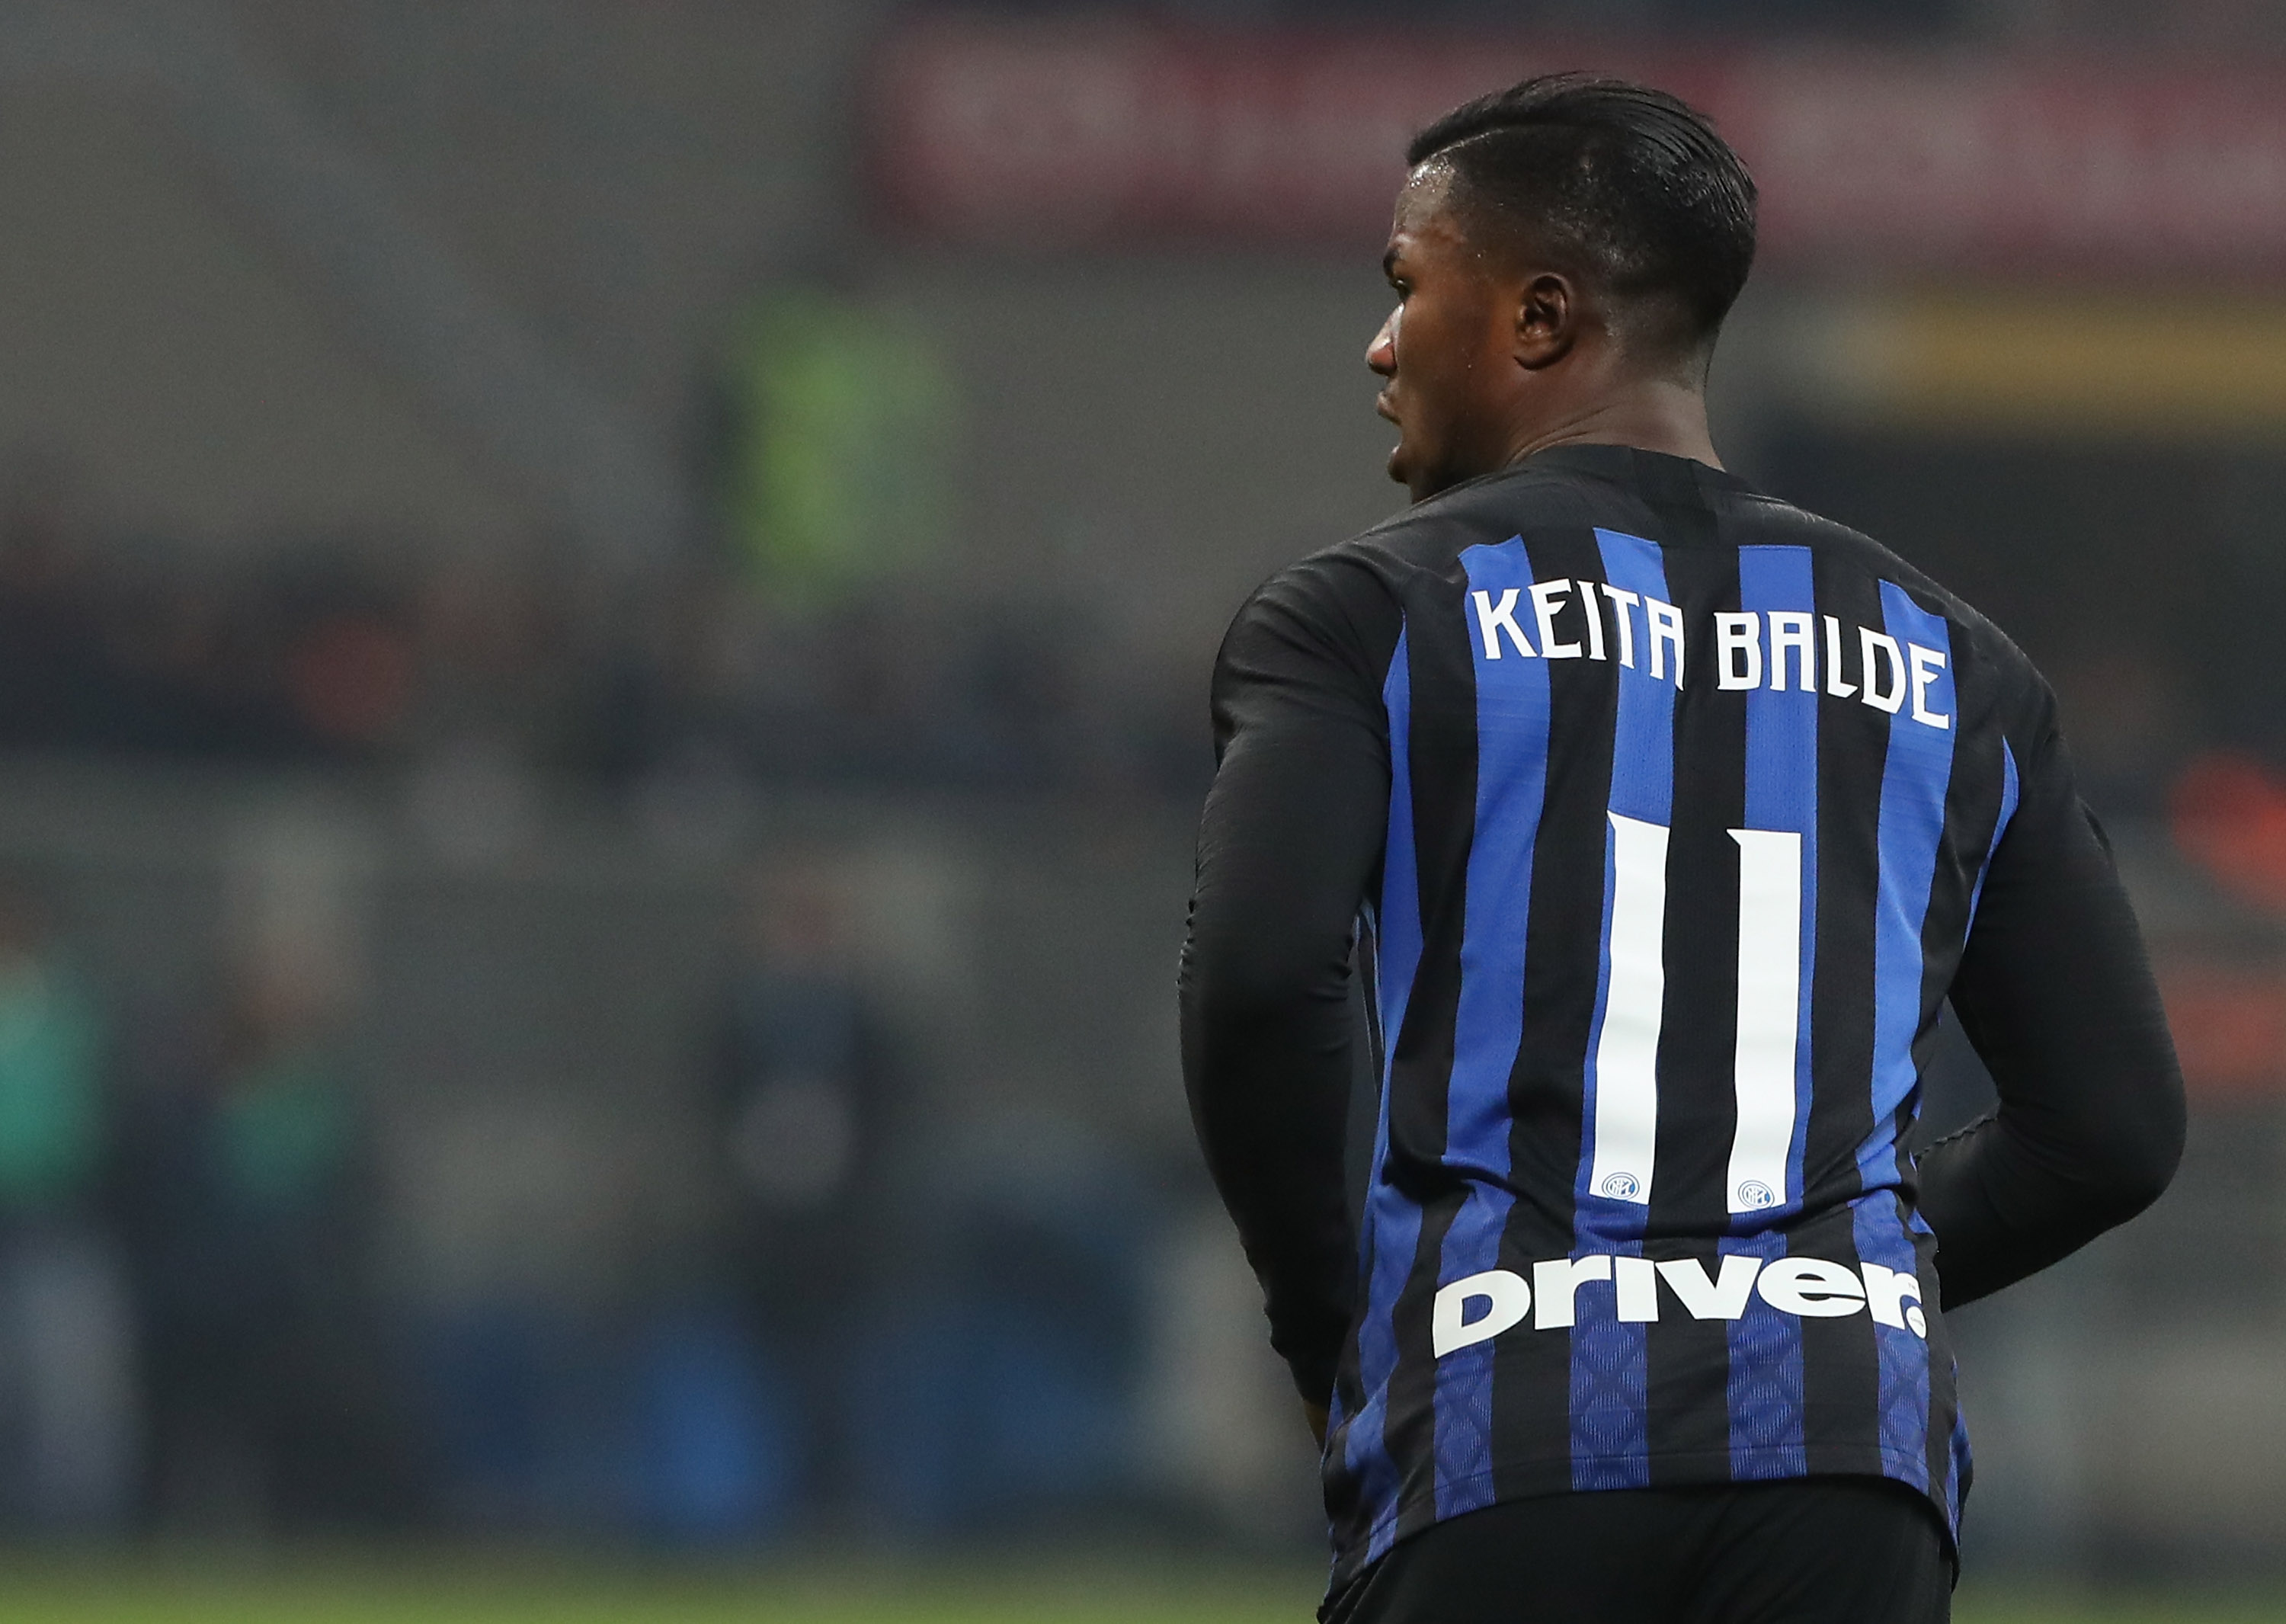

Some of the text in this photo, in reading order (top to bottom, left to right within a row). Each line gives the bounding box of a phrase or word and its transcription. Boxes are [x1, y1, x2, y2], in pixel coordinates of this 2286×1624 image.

[1471, 578, 1950, 729] KEITA BALDE
[1589, 809, 1802, 1214] 11
